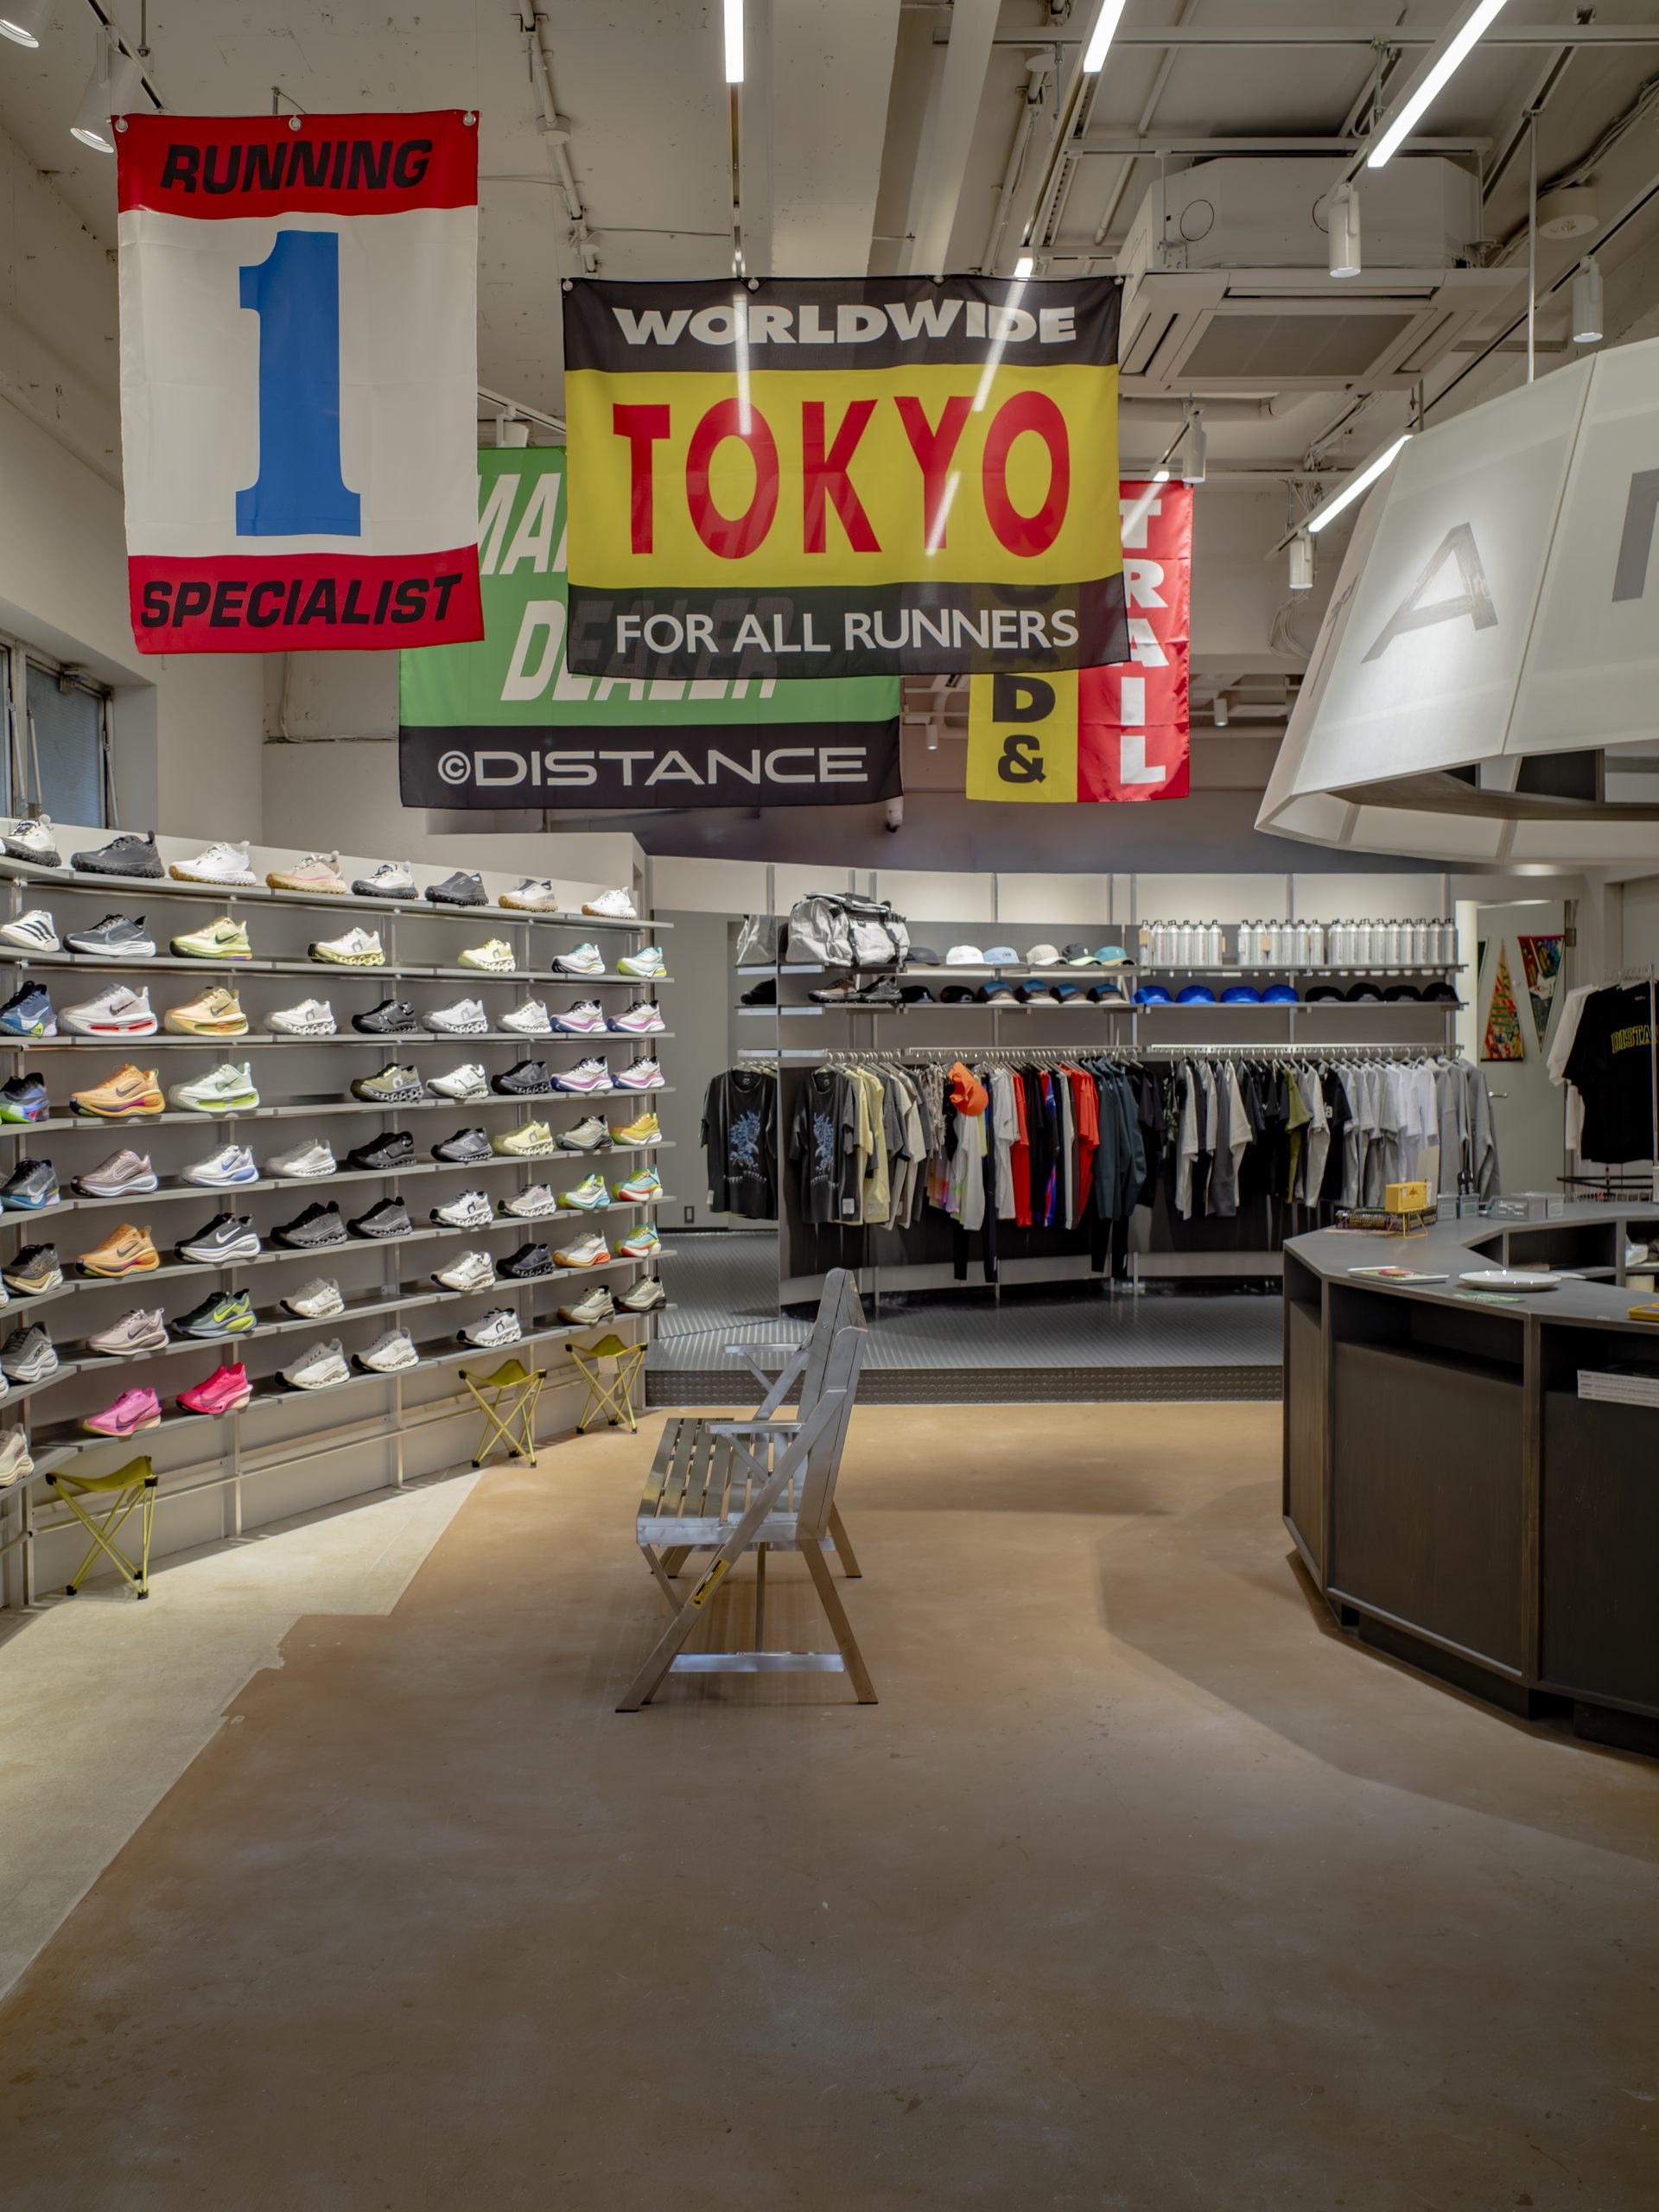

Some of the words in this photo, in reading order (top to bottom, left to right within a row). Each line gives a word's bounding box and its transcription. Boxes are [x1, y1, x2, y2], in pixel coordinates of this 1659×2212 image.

[160, 139, 434, 194] RUNNING
[612, 298, 1077, 345] WORLDWIDE
[235, 229, 361, 537] 1
[612, 390, 1071, 560] TOKYO
[140, 572, 464, 628] SPECIALIST
[615, 613, 719, 654] FOR
[732, 612, 831, 652] ALL
[844, 608, 1079, 650] RUNNERS
[1120, 499, 1170, 785] TRAIL
[997, 734, 1047, 784] &
[1611, 1025, 1659, 1053] DISTA
